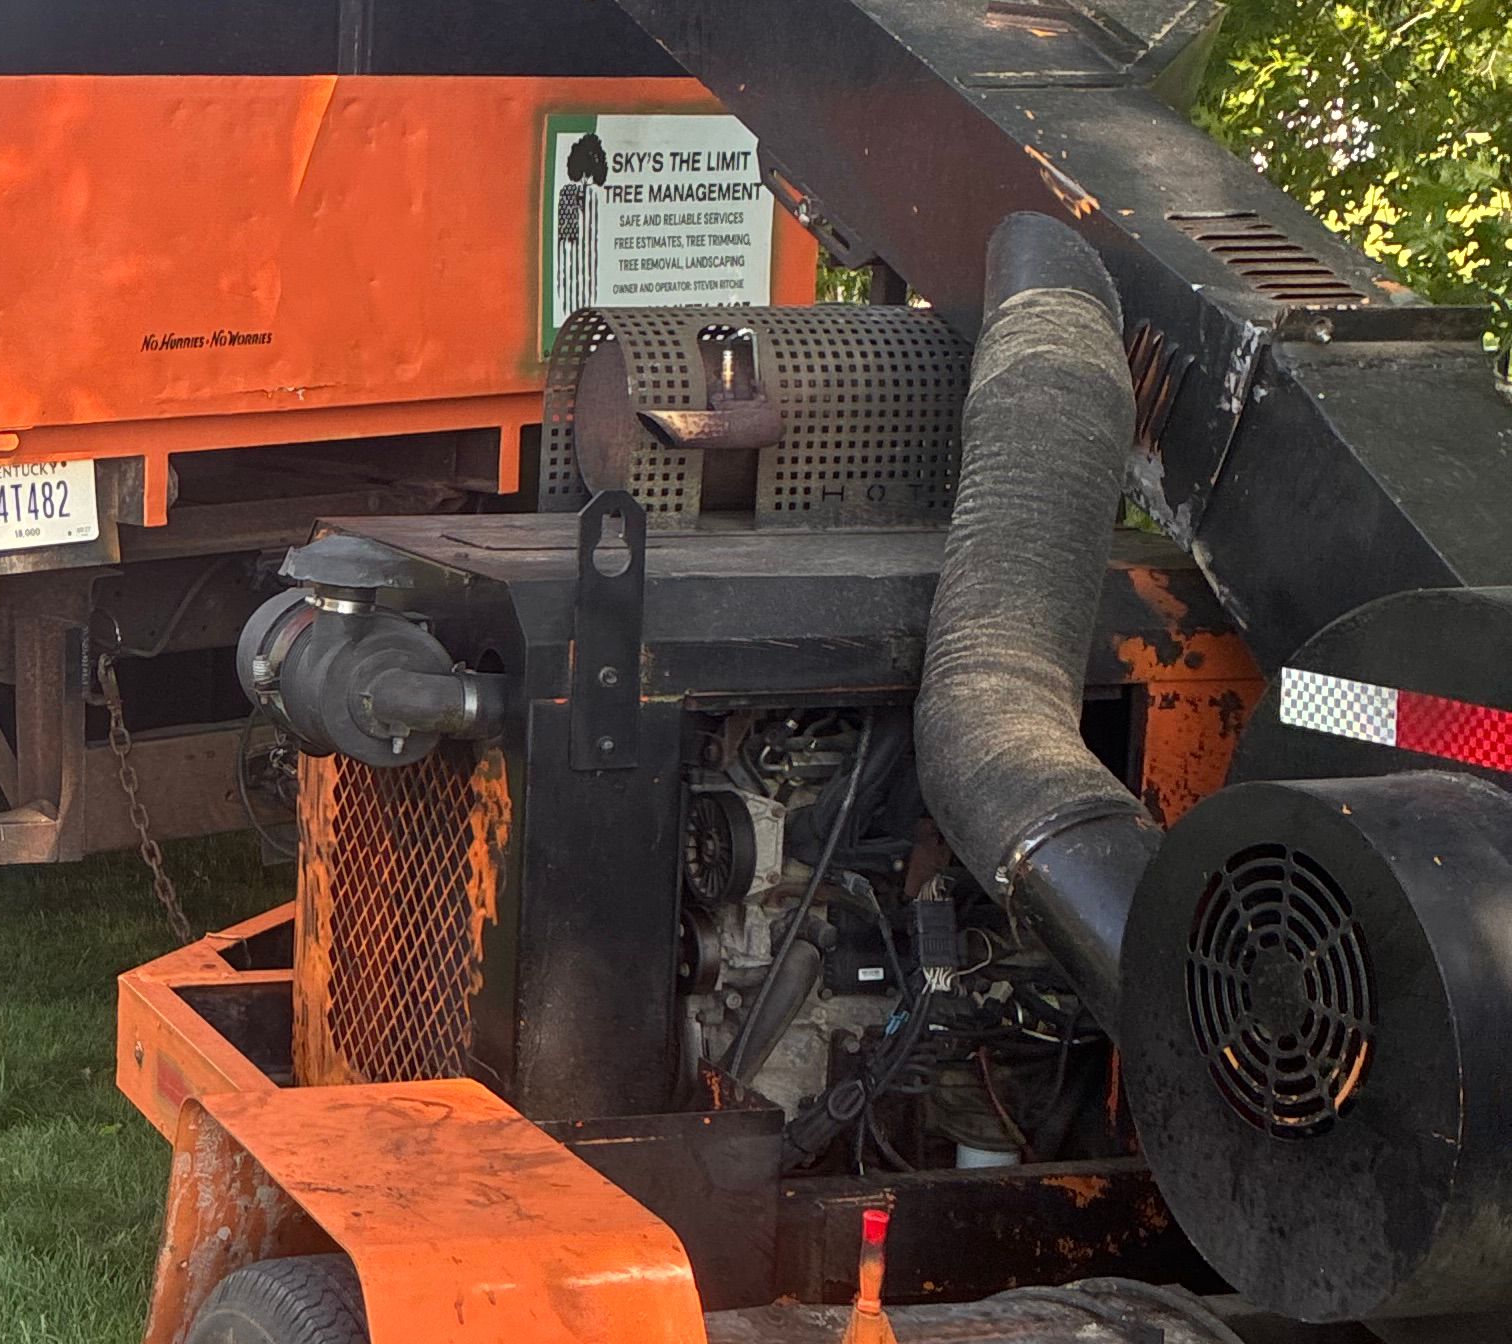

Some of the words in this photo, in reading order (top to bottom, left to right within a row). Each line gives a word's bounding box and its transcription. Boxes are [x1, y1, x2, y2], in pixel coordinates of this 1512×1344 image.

[612, 152, 664, 173] SKY'S
[669, 152, 702, 171] THE
[707, 151, 751, 171] LIMIT
[604, 185, 643, 203] TREE
[649, 183, 761, 202] MANAGEMENT
[619, 214, 641, 227] SAFE
[643, 214, 661, 226] AND
[664, 212, 702, 226] RELIABLE
[704, 212, 744, 225] SERVICES
[614, 237, 634, 250] FREE
[636, 235, 684, 249] ESTIMATES,
[686, 235, 706, 247] TREE
[707, 233, 751, 247] TRIMMING,
[619, 259, 638, 271] TREE
[686, 255, 745, 269] LANDSCAPING
[613, 283, 638, 295] OWNER
[640, 282, 654, 293] AND
[655, 281, 692, 293] OPERATOR:
[694, 279, 718, 291] STEVEN
[719, 278, 744, 289] RITCHIE
